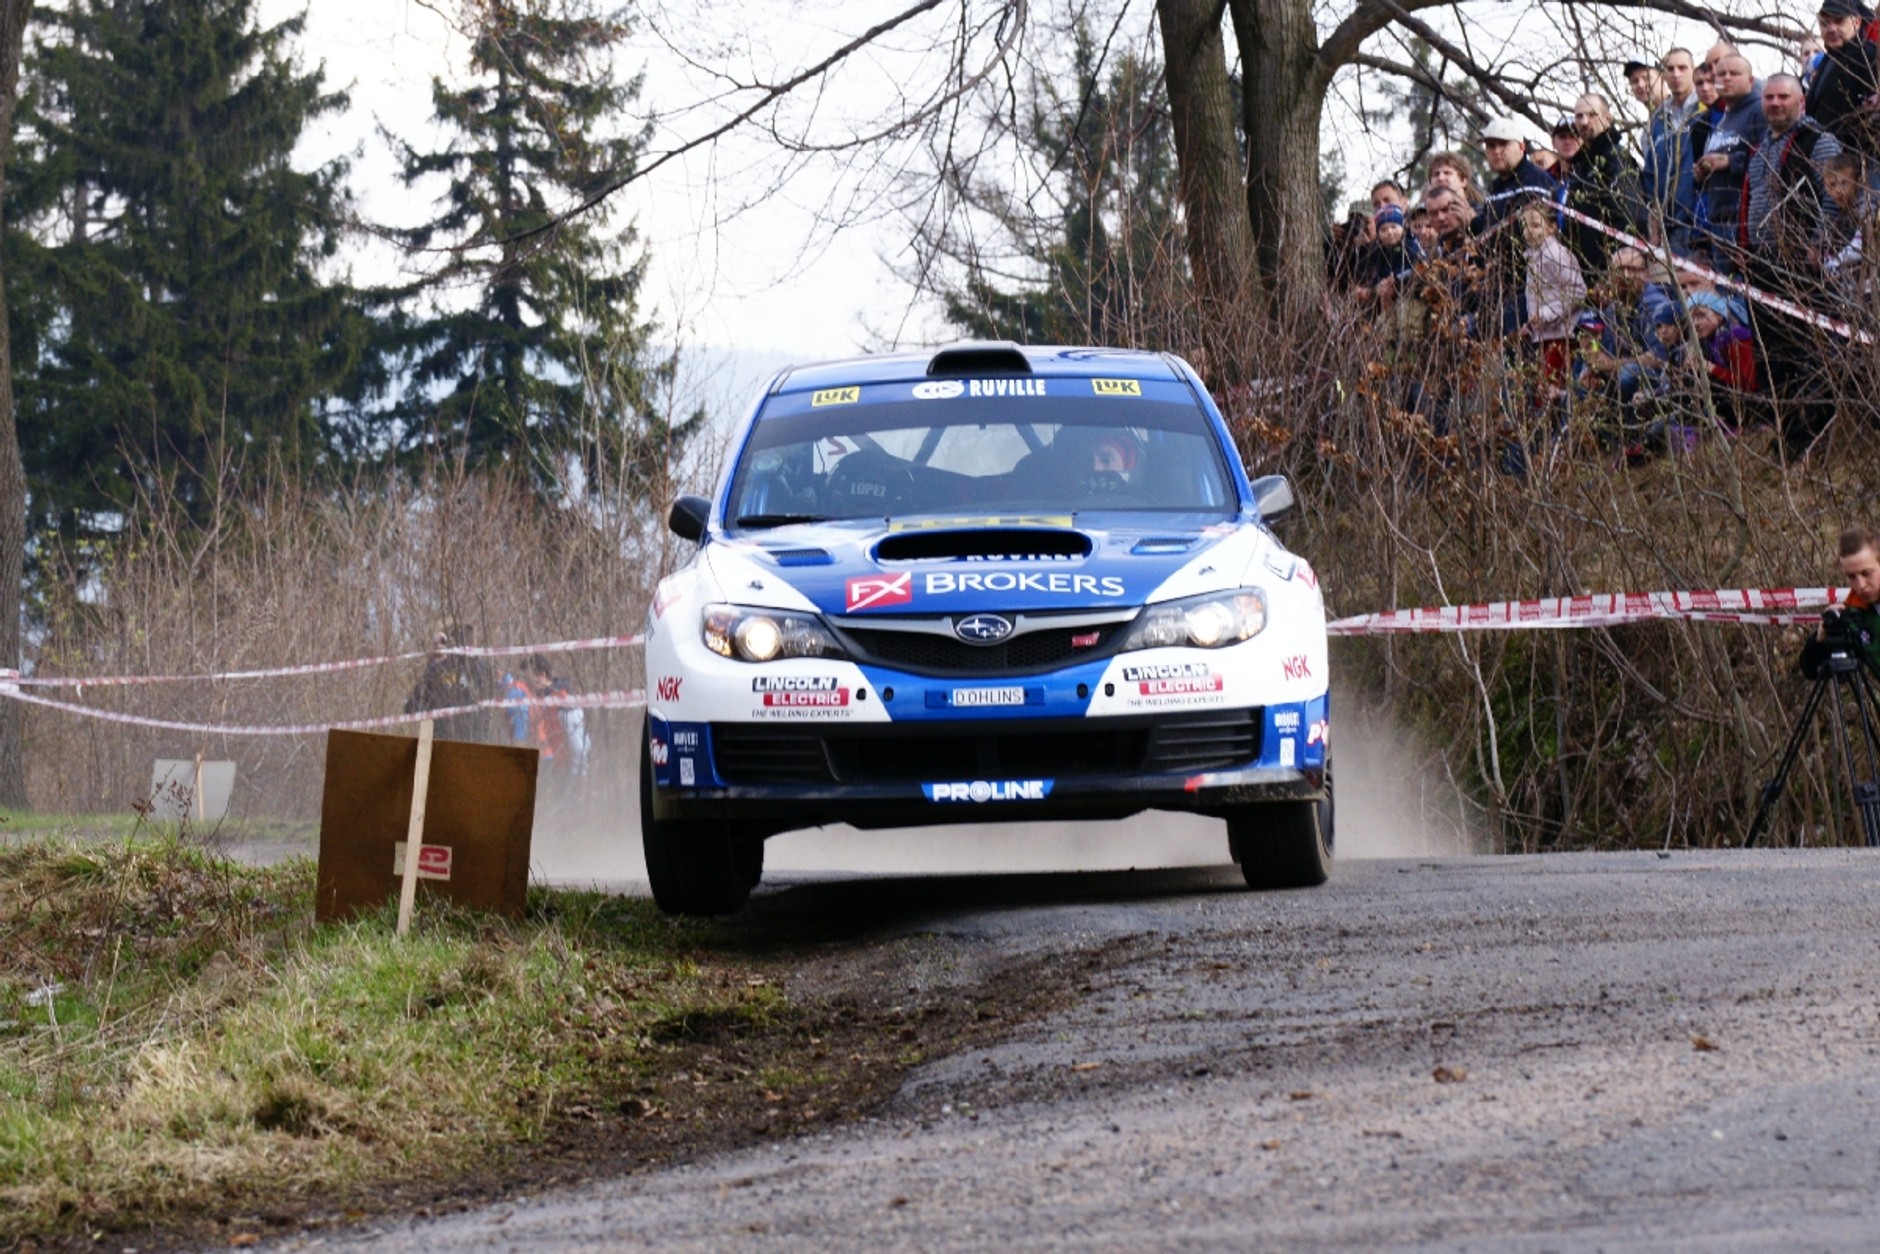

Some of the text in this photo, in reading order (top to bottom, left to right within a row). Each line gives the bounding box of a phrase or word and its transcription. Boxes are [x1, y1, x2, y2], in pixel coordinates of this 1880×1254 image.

[969, 379, 1047, 397] RUVILLE
[847, 571, 1125, 613] FX BROKERS
[1127, 663, 1206, 680] LINCOLN
[1282, 654, 1312, 681] NGK
[656, 676, 683, 702] NGK
[755, 677, 834, 691] LINCOLN
[1149, 679, 1216, 693] ELECTRIC
[772, 692, 841, 705] ELECTRIC
